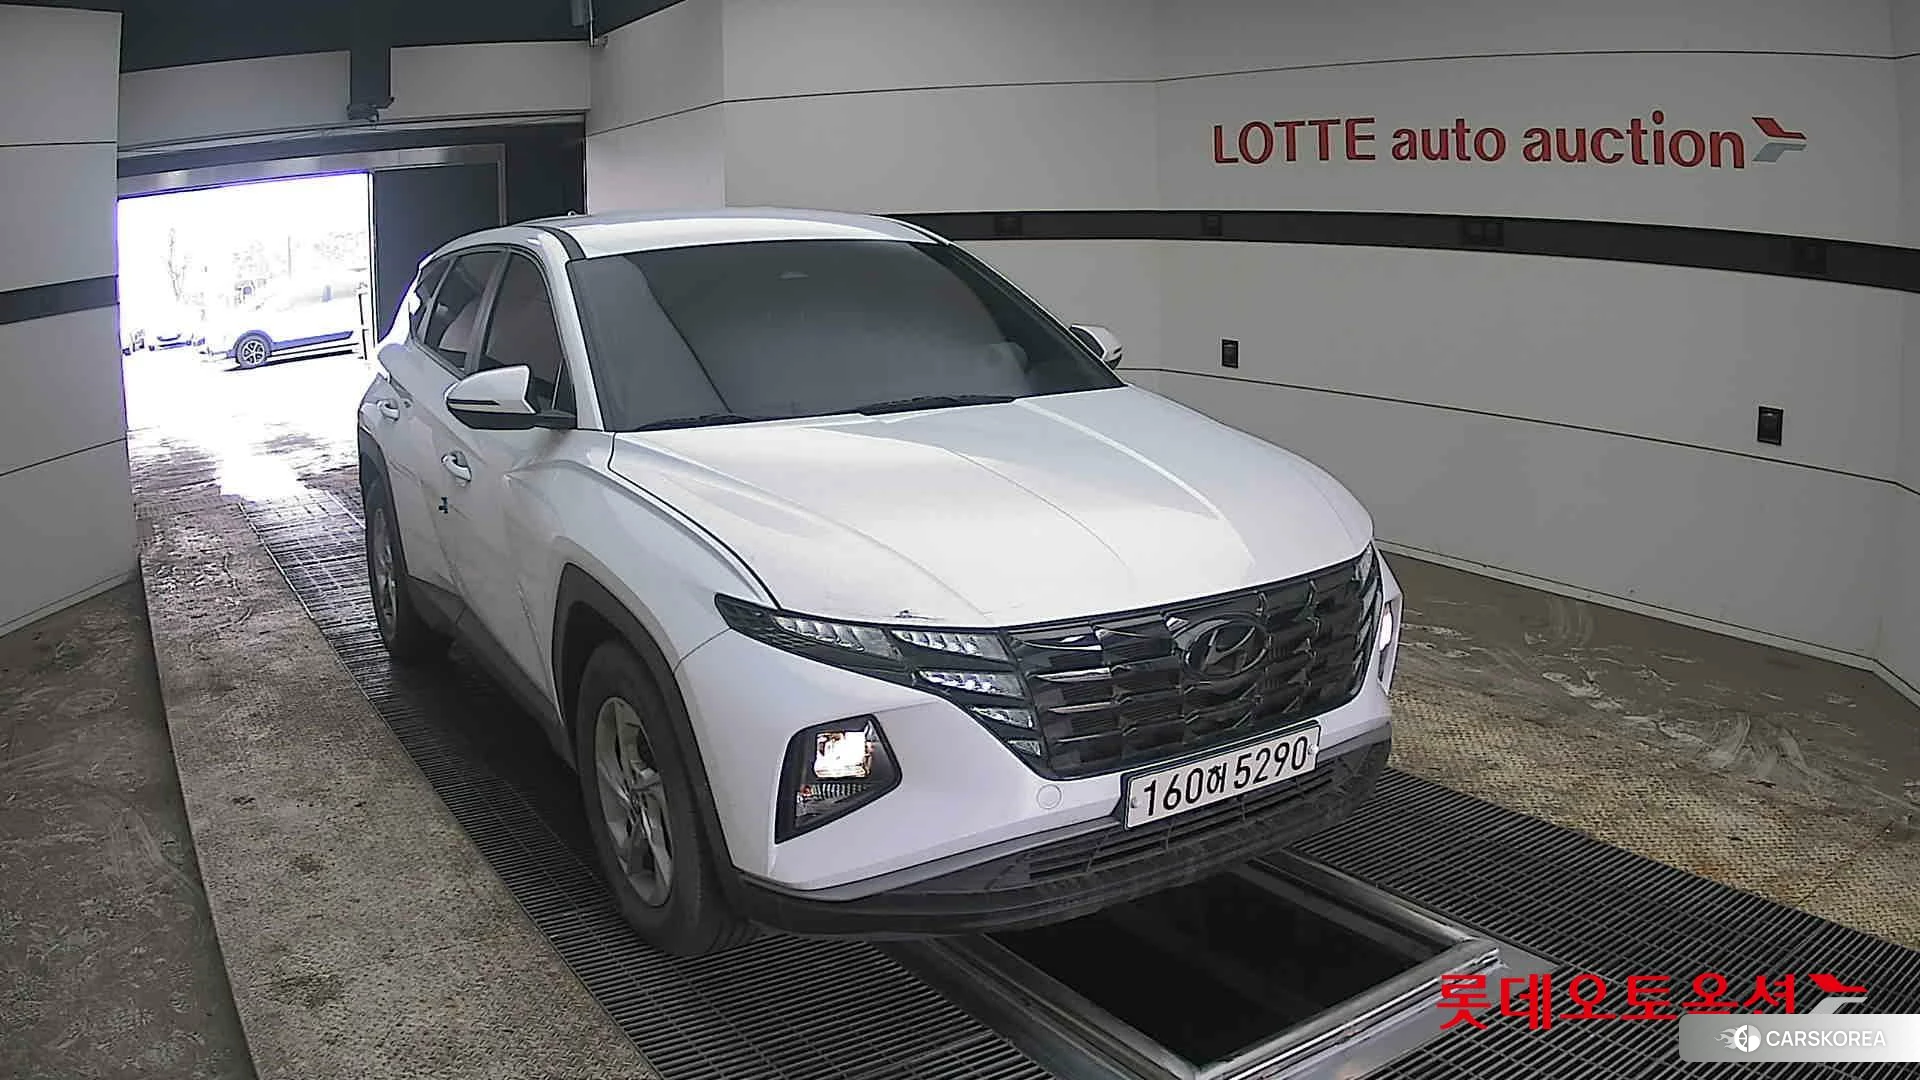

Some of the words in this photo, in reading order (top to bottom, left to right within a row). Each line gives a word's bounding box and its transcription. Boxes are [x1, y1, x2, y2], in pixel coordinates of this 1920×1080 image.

[1213, 117, 1376, 164] LOTTE
[1391, 118, 1506, 162] auto
[1522, 110, 1745, 169] auction
[1143, 762, 1228, 817] 160허
[1233, 735, 1309, 790] 5290
